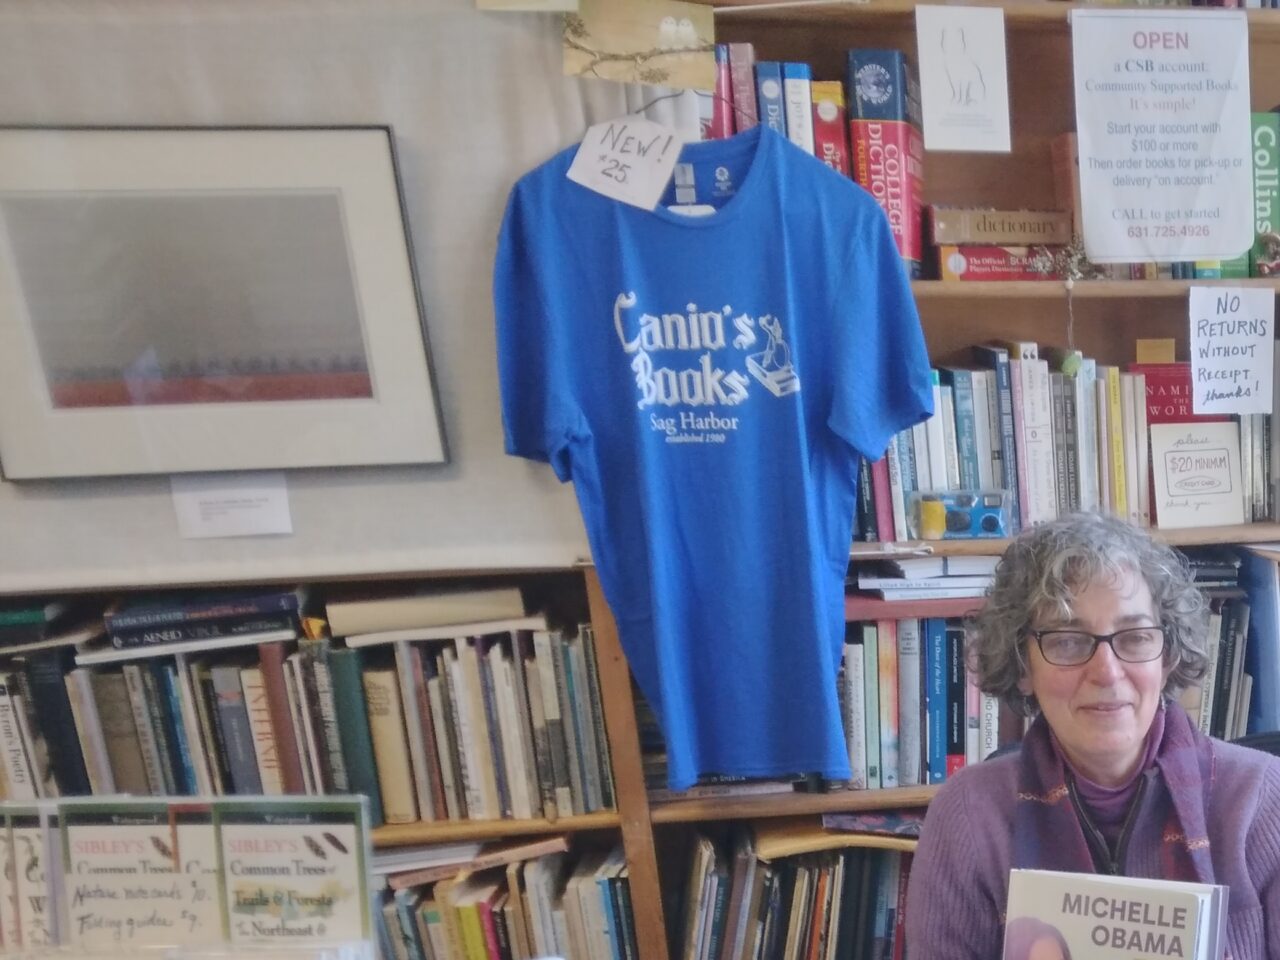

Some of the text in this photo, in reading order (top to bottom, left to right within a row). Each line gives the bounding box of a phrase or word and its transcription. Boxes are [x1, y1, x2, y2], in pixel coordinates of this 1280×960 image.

[1133, 31, 1189, 49] OPEN
[1114, 63, 1120, 72] a
[1125, 59, 1154, 72] CSB
[1085, 79, 1146, 93] Community
[1151, 79, 1202, 94] Supported
[1153, 98, 1196, 112] simple!
[1107, 121, 1221, 137] Start your account with
[600, 124, 673, 162] NEW!
[1131, 139, 1198, 152] $100 or more
[868, 123, 886, 206] DICTION
[1088, 157, 1242, 171] Then order books for pick-up or
[1113, 175, 1151, 189] delivery
[1254, 125, 1279, 234] Collins
[884, 144, 902, 236] COLLEGE
[976, 214, 1057, 233] dictionary
[1112, 207, 1220, 222] CALL to get started
[1127, 225, 1210, 238] 631.725.4926
[1216, 292, 1241, 315] NO
[614, 291, 757, 353] Canio's
[1197, 318, 1268, 338] RETURNS
[1199, 340, 1257, 359] WITHOUT
[631, 351, 750, 409] Books
[1198, 368, 1251, 383] RECEIPT
[1149, 406, 1189, 416] WOR
[650, 411, 739, 435] Sag Harbor
[1195, 456, 1227, 471] MINIMUM
[985, 712, 993, 749] CHURCH
[75, 839, 145, 852] SIBLEY'S
[229, 838, 299, 852] SIBLEY'S
[230, 859, 327, 877] Common Trees
[1062, 893, 1187, 929] MICHELLE
[251, 919, 313, 938] Northeast
[1091, 925, 1184, 957] OBAMA
